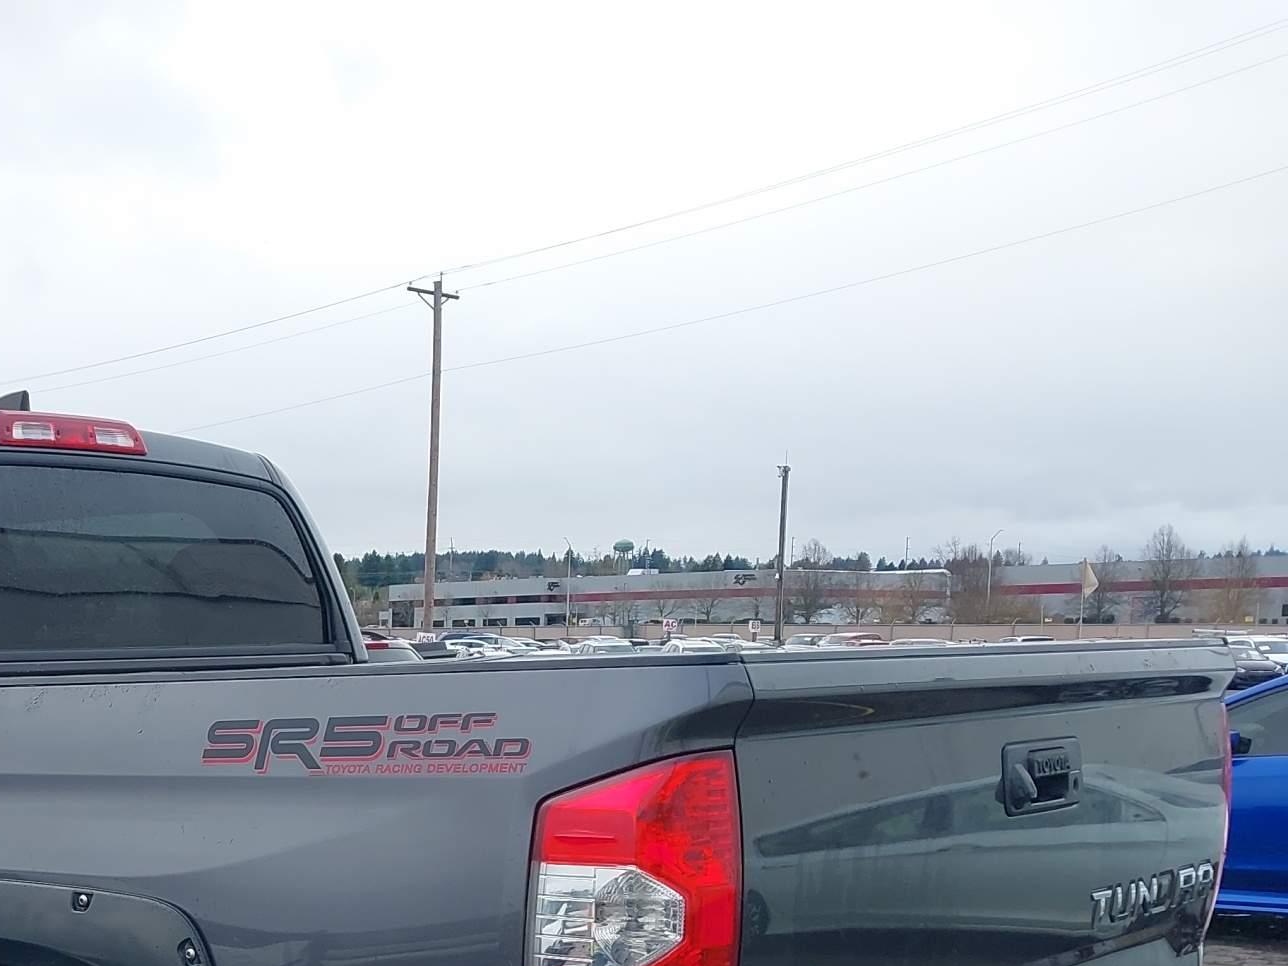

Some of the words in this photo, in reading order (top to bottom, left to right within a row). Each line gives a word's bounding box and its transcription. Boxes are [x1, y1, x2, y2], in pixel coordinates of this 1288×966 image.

[393, 712, 498, 735] OFF
[201, 715, 392, 776] SR5
[385, 737, 533, 761] ROAD
[325, 763, 371, 775] TOYOTA
[375, 763, 422, 774] RACING
[427, 762, 528, 774] DEVELOPMENT
[1091, 859, 1215, 925] TUNDRA
